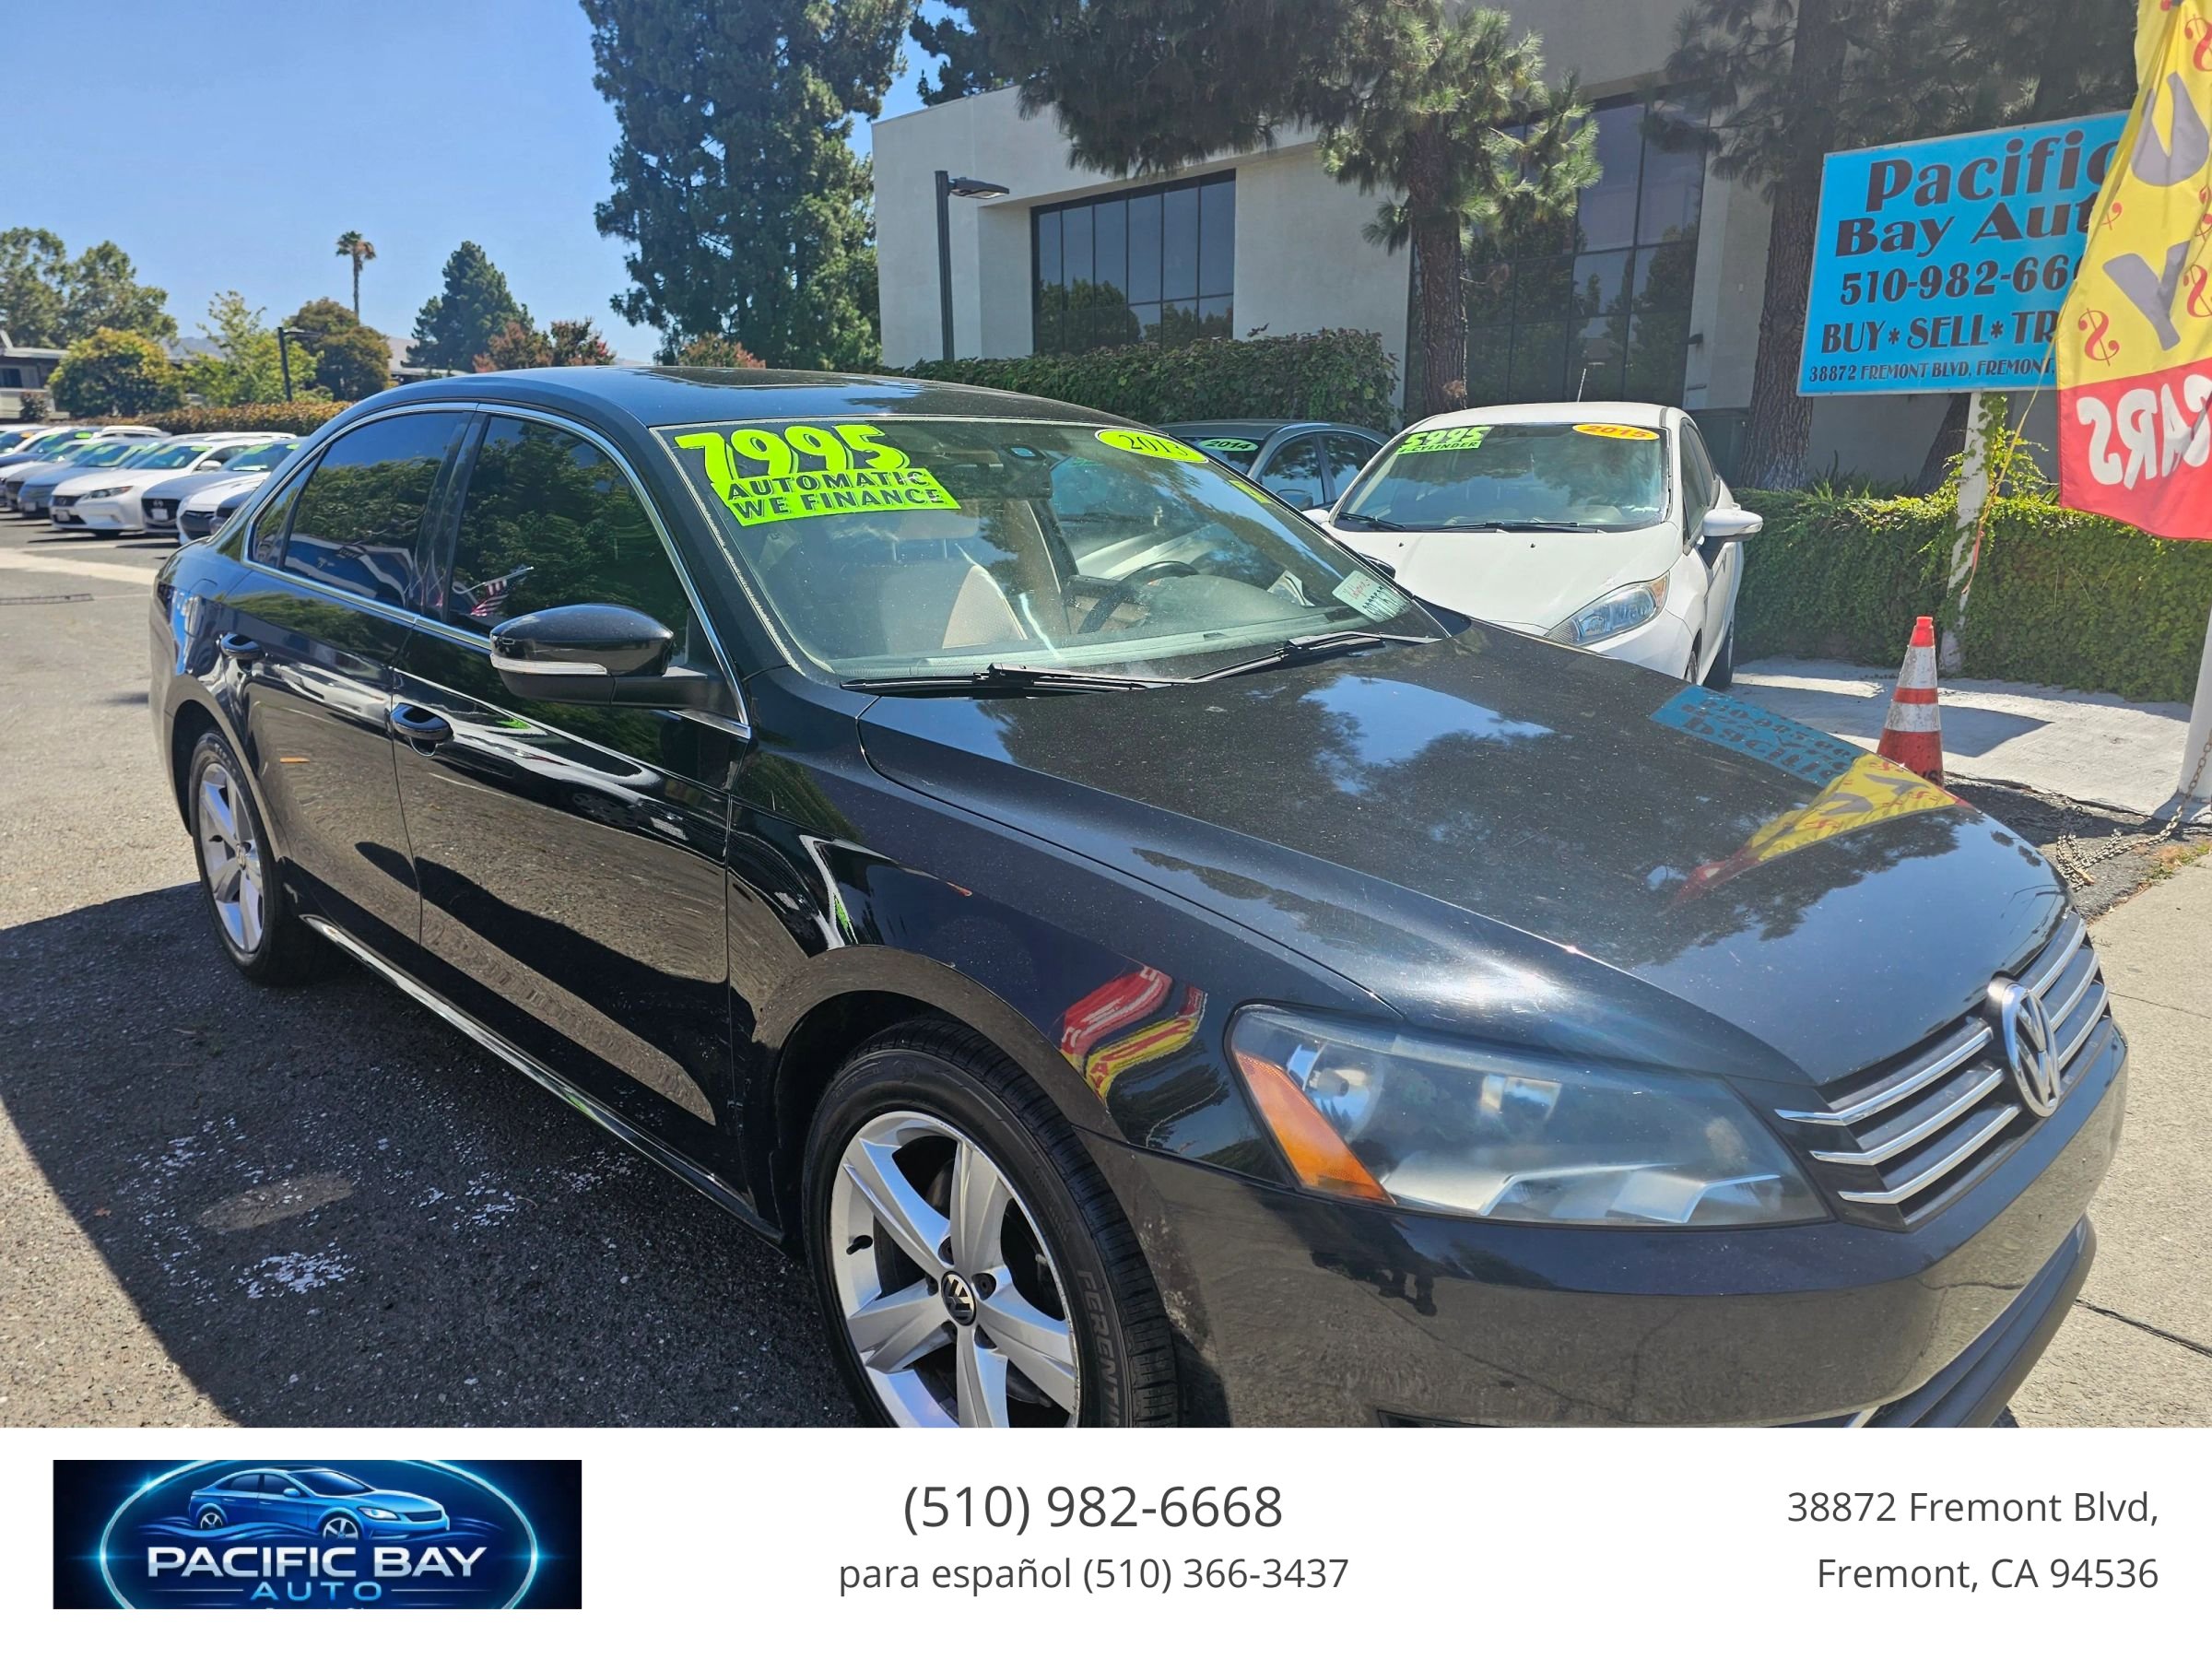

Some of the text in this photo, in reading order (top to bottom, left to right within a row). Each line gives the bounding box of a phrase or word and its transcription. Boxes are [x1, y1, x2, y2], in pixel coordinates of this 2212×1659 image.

[1835, 216, 1955, 257] Bay
[1809, 365, 1856, 382] 38872
[1860, 362, 1929, 380] FREMONT
[1932, 360, 1971, 379] BLVD,
[1404, 427, 1490, 451] 5995
[1583, 425, 1650, 438] 2015
[674, 424, 911, 483] 7995
[1118, 434, 1189, 456] 2013
[1205, 441, 1252, 449] 2014
[728, 471, 929, 500] AUTOMATIC
[732, 488, 945, 520] WE FINANCE
